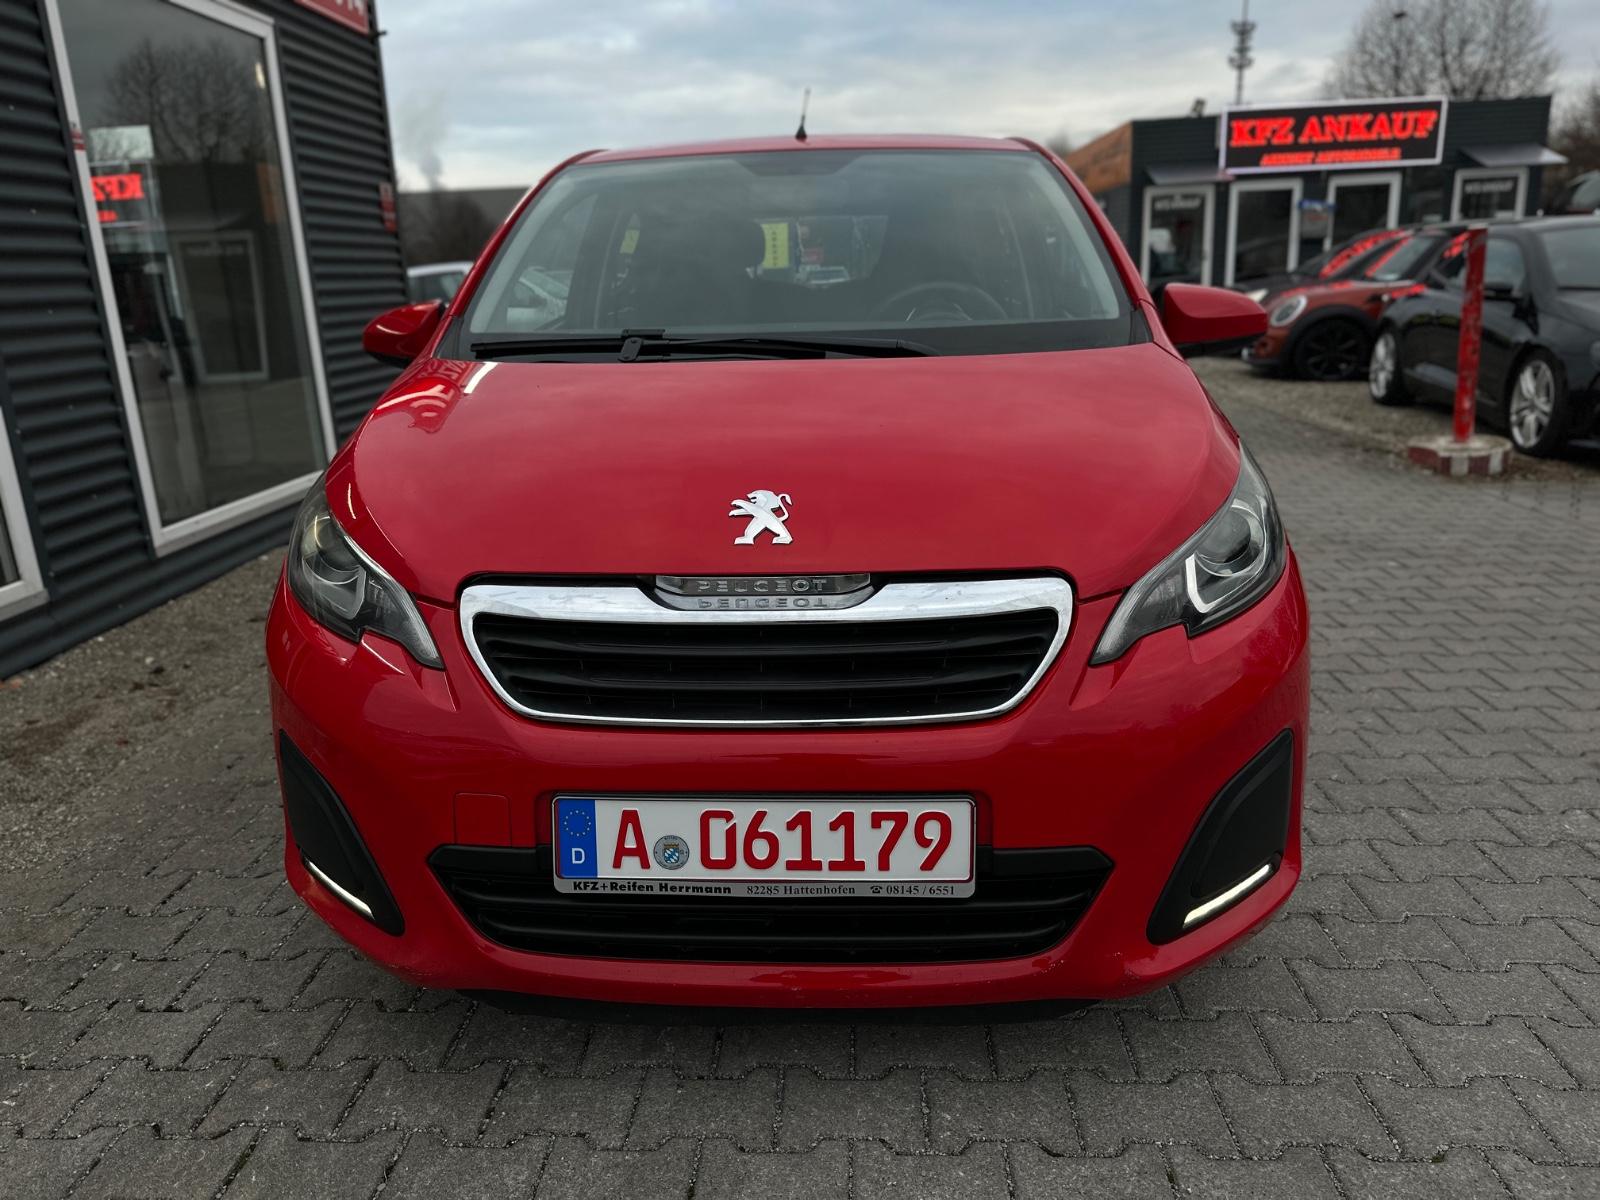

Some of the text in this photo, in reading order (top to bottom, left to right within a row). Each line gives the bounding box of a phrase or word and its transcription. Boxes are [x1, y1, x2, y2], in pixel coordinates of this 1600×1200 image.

[1230, 110, 1438, 147] KFZ ANKAUF
[697, 579, 827, 592] PEUGEOT
[612, 809, 952, 871] A 061179
[571, 848, 586, 864] D
[573, 881, 654, 893] KFZ+Reifen
[659, 882, 732, 895] Herrmann
[746, 885, 780, 896] 82285
[784, 884, 856, 896] Hattenhofen
